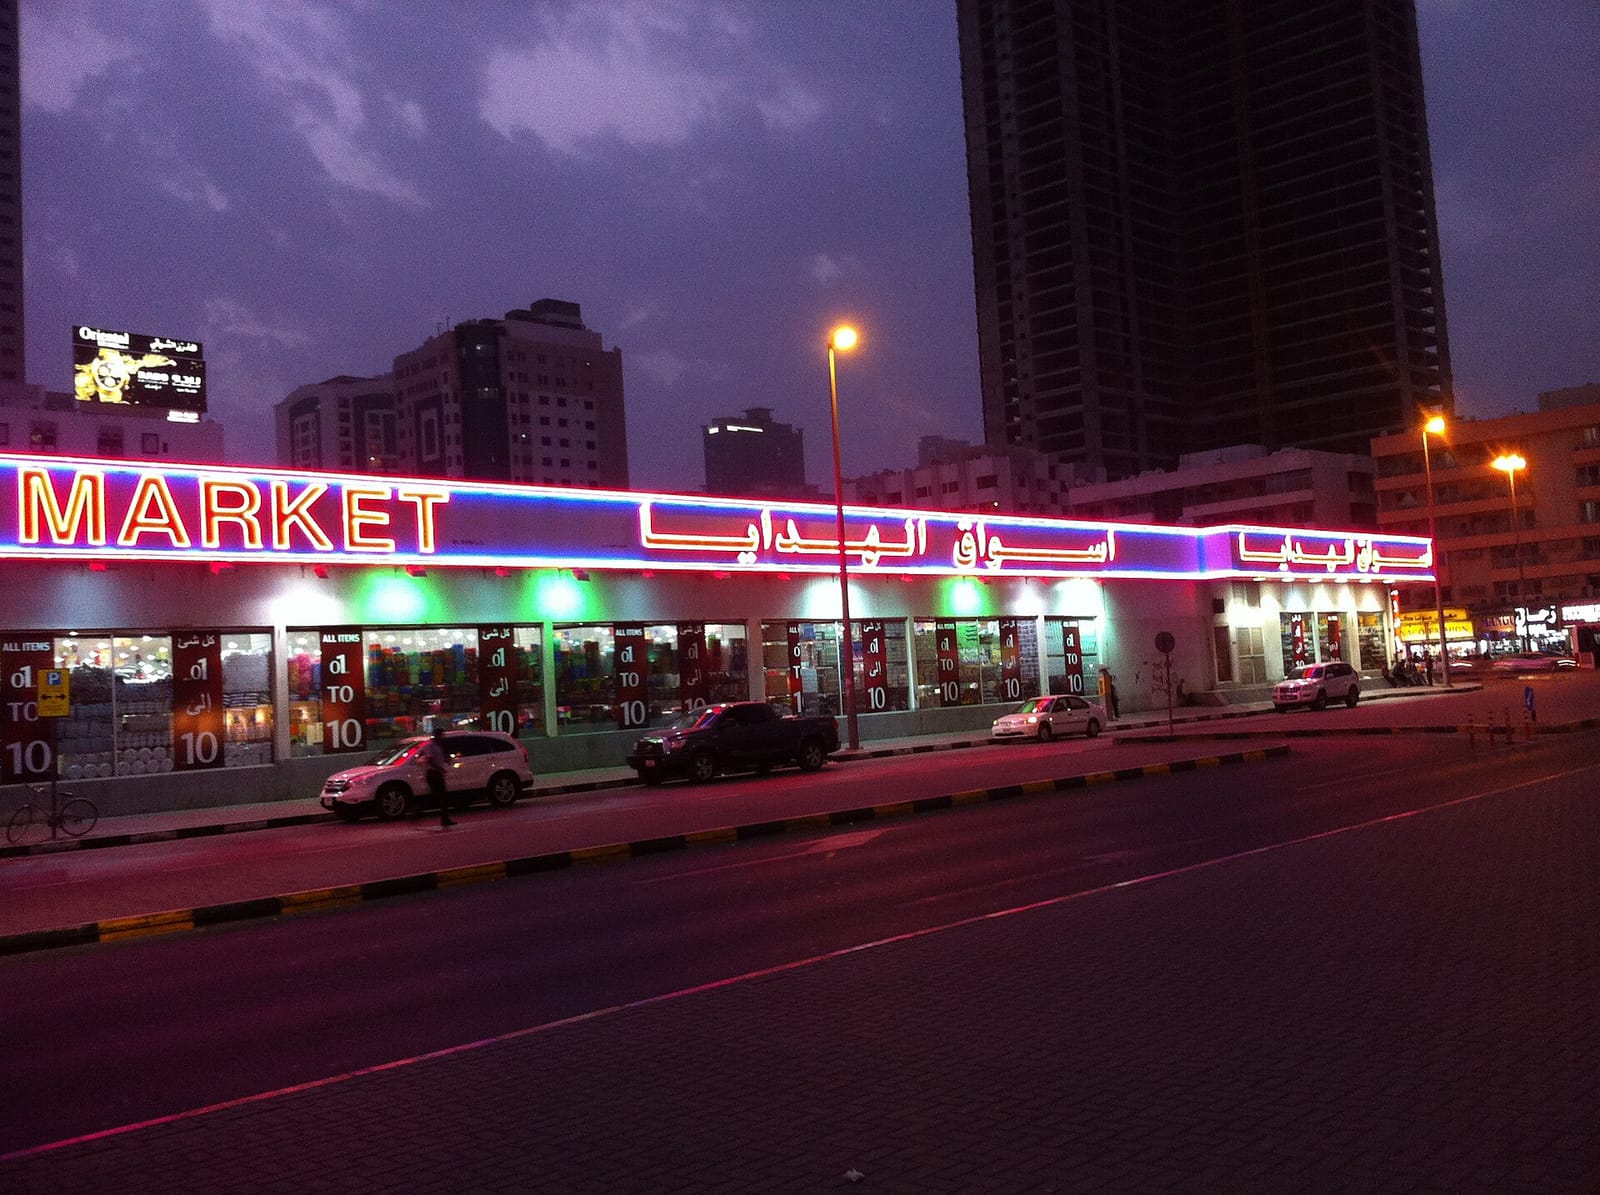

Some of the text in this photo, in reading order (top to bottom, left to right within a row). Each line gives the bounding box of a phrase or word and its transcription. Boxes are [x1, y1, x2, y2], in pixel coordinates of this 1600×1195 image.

[18, 466, 451, 554] MARKET
[3, 642, 51, 652] ALL ITEMS
[322, 634, 360, 643] ALL ITEMS
[940, 658, 954, 671] TO
[1066, 653, 1078, 665] TO
[48, 672, 60, 686] P
[619, 672, 639, 688] TO
[1004, 678, 1020, 698] 10
[1067, 673, 1082, 693] 10
[327, 685, 354, 703] TO
[867, 687, 886, 709] 10
[941, 681, 959, 702] 10
[486, 710, 515, 735] 10
[620, 700, 646, 726] 10
[326, 719, 362, 749] 10
[6, 740, 51, 774] 10
[181, 731, 218, 765] 10
